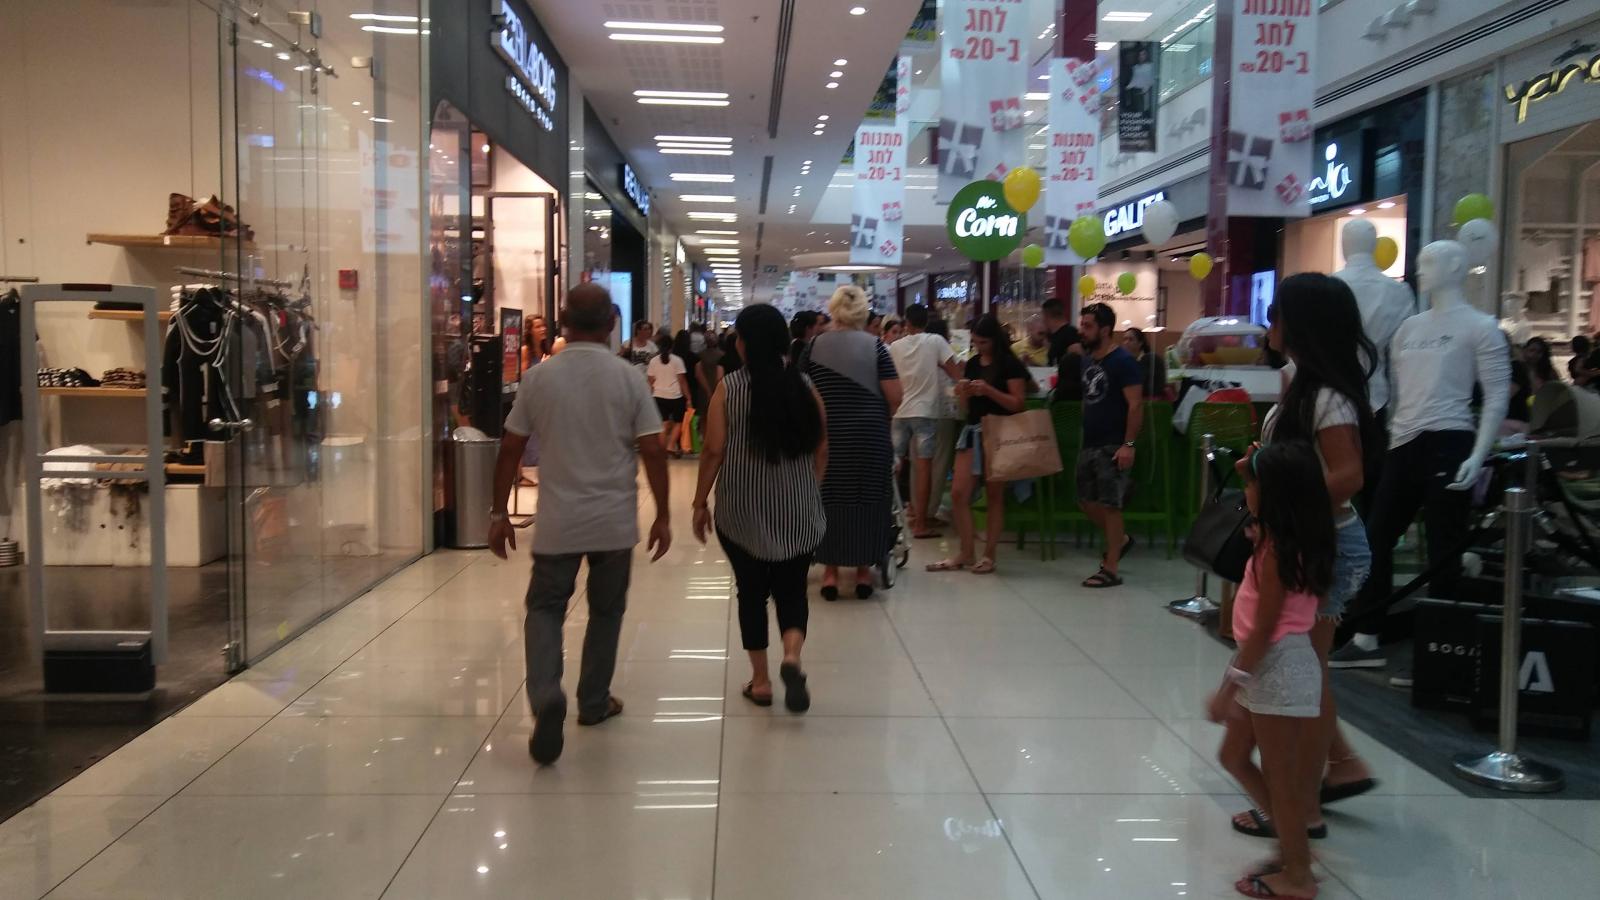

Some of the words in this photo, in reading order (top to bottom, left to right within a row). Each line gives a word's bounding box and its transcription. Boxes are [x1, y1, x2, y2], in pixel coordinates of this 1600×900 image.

[964, 6, 1008, 32] לחג
[1255, 20, 1296, 46] לחג
[860, 132, 902, 146] מתנות
[1053, 132, 1094, 147] מתנות
[867, 148, 893, 164] לחג
[1061, 149, 1086, 165] לחג
[955, 207, 1018, 237] Corn
